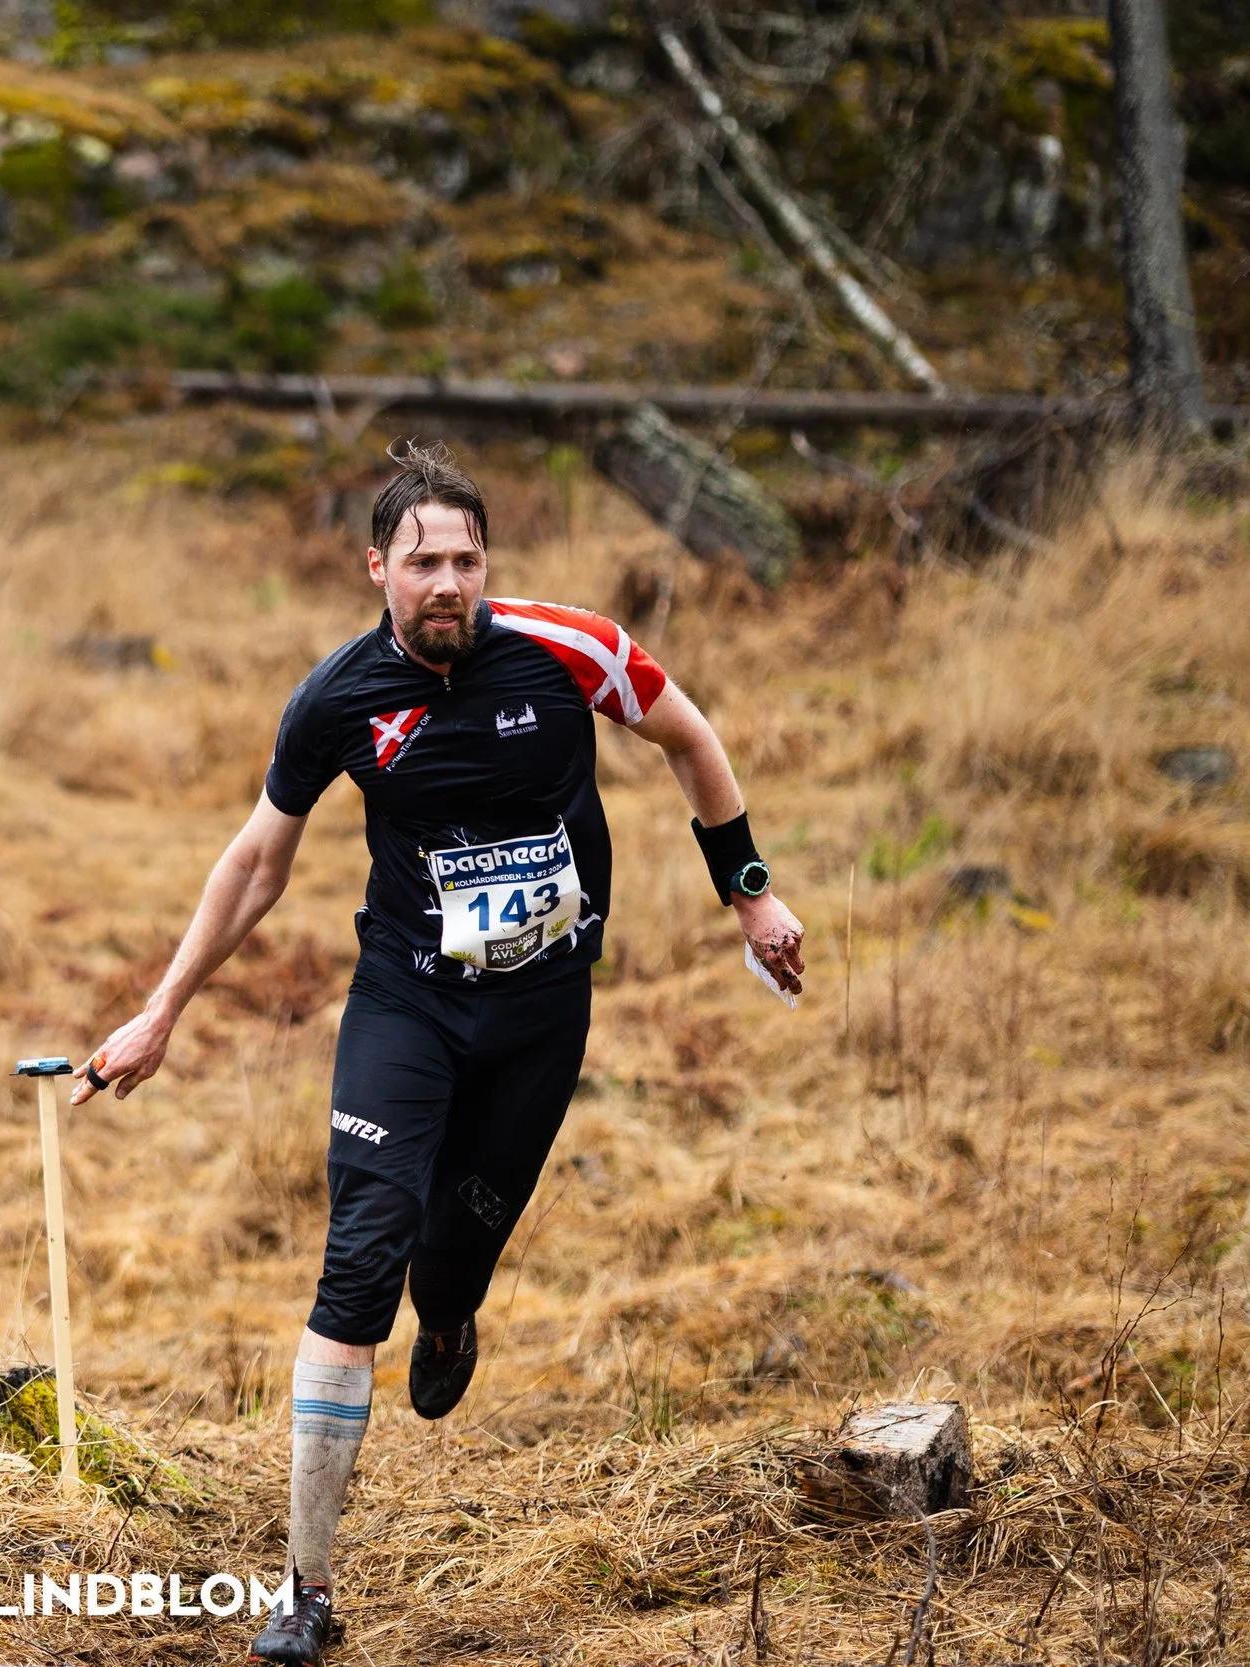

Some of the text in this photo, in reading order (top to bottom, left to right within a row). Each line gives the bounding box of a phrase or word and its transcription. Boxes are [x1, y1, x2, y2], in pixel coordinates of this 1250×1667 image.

[419, 713, 432, 727] OK
[436, 834, 568, 877] bagheera
[454, 873, 522, 888] KOLMÅRDSMEDELN
[526, 872, 536, 880] SL
[536, 869, 548, 878] #2
[548, 862, 563, 875] 2026
[467, 882, 561, 932] 143
[490, 929, 539, 951] GODKÄNDA
[491, 935, 538, 961] AVLOPP
[331, 1109, 390, 1145] RIMTEX
